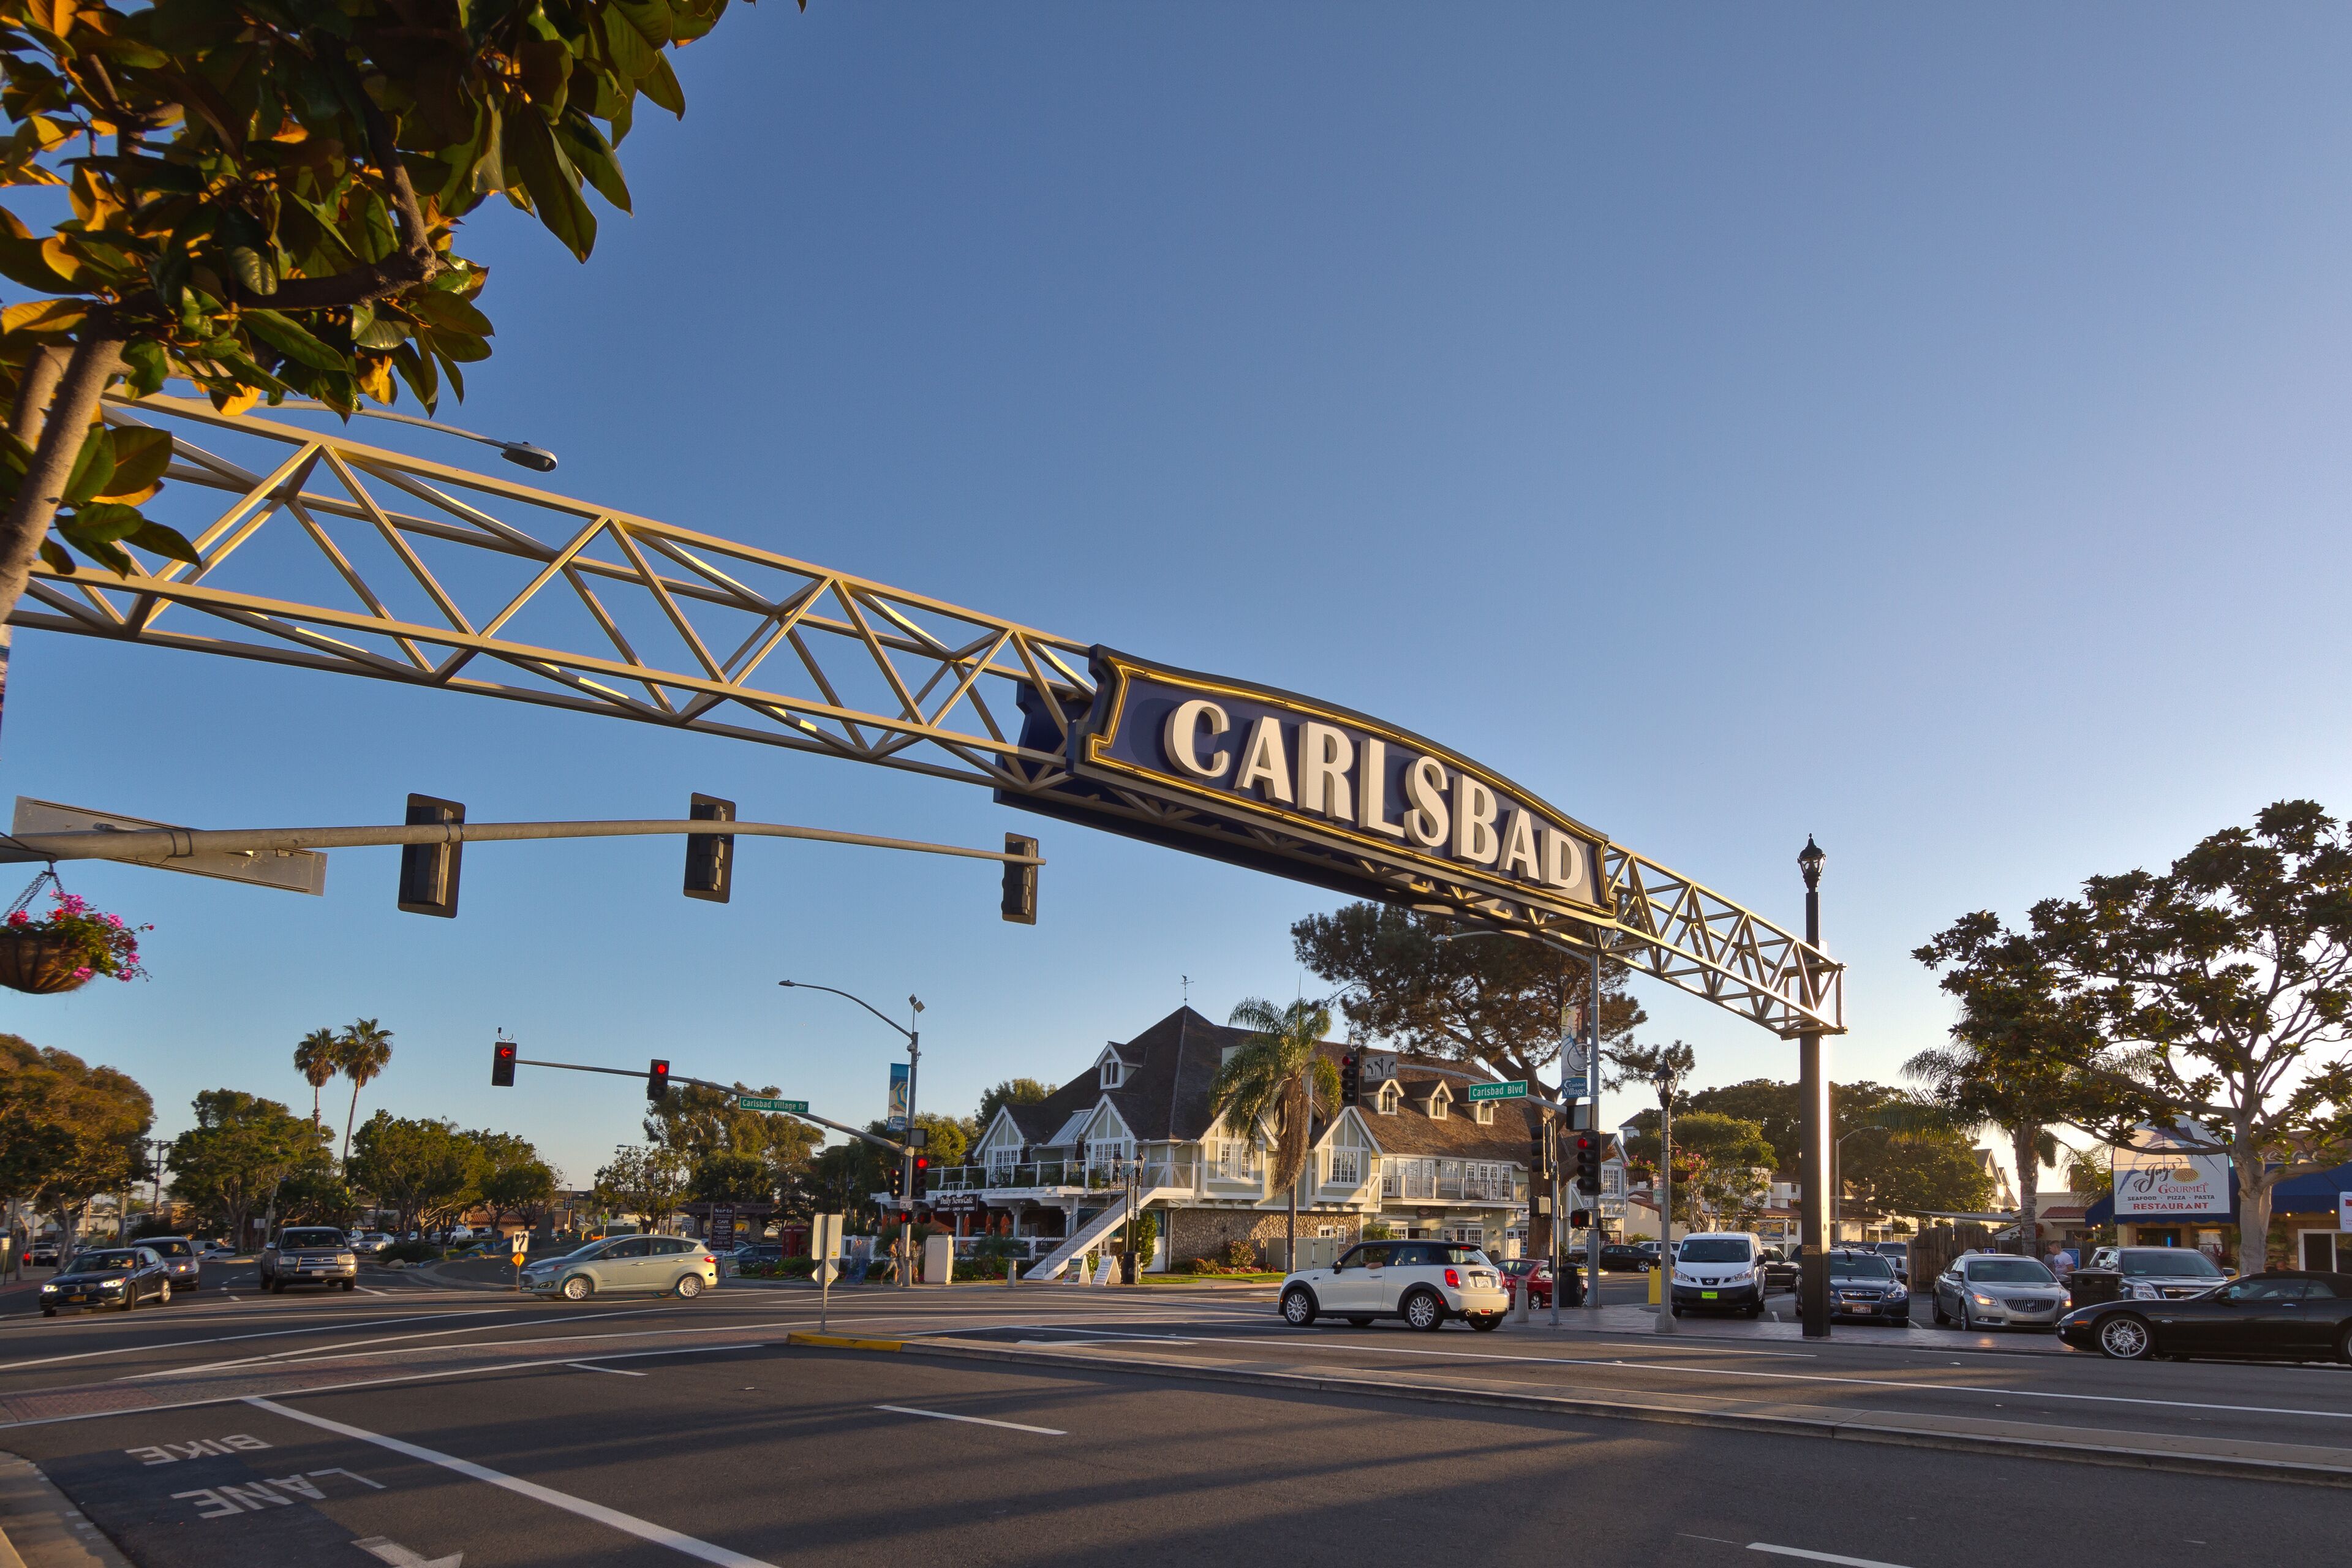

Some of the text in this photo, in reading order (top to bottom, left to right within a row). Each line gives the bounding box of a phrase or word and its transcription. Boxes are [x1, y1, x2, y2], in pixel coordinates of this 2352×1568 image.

[1165, 699, 1584, 890] CARLSBAD
[1472, 1084, 1523, 1097] Carlsbad Blvd
[1564, 1088, 1585, 1096] Village
[742, 1099, 772, 1108] Carlsbad
[774, 1101, 796, 1111] Village
[125, 1434, 273, 1465] BIKE
[170, 1468, 387, 1519] LANE
